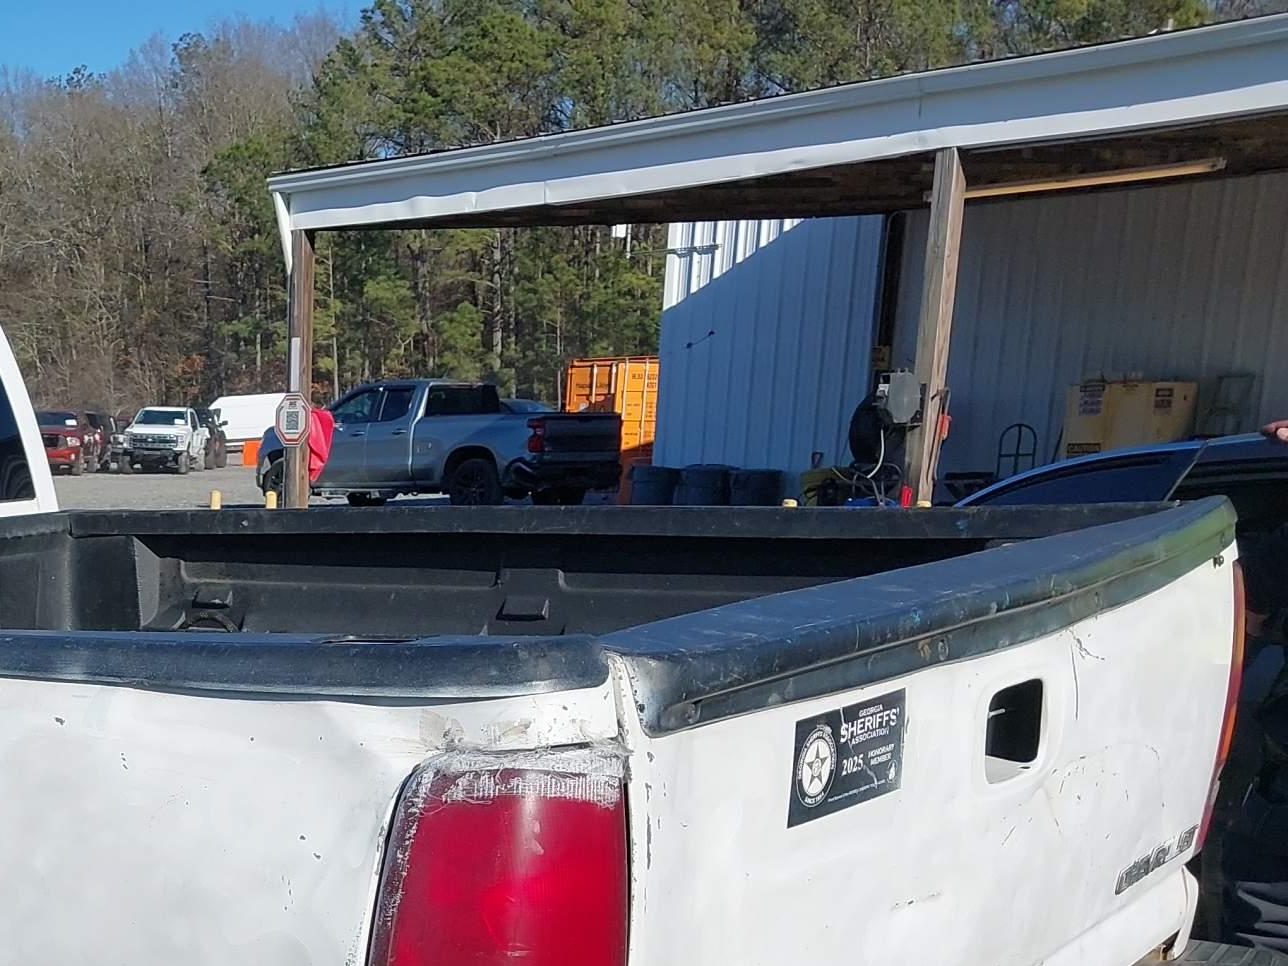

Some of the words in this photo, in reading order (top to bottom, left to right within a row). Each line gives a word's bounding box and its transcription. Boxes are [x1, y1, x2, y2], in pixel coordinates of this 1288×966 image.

[858, 704, 884, 717] GEORGIA
[840, 707, 900, 743] SHERIFFS'
[850, 728, 889, 745] ASSOCIATION
[841, 754, 864, 777] 2025
